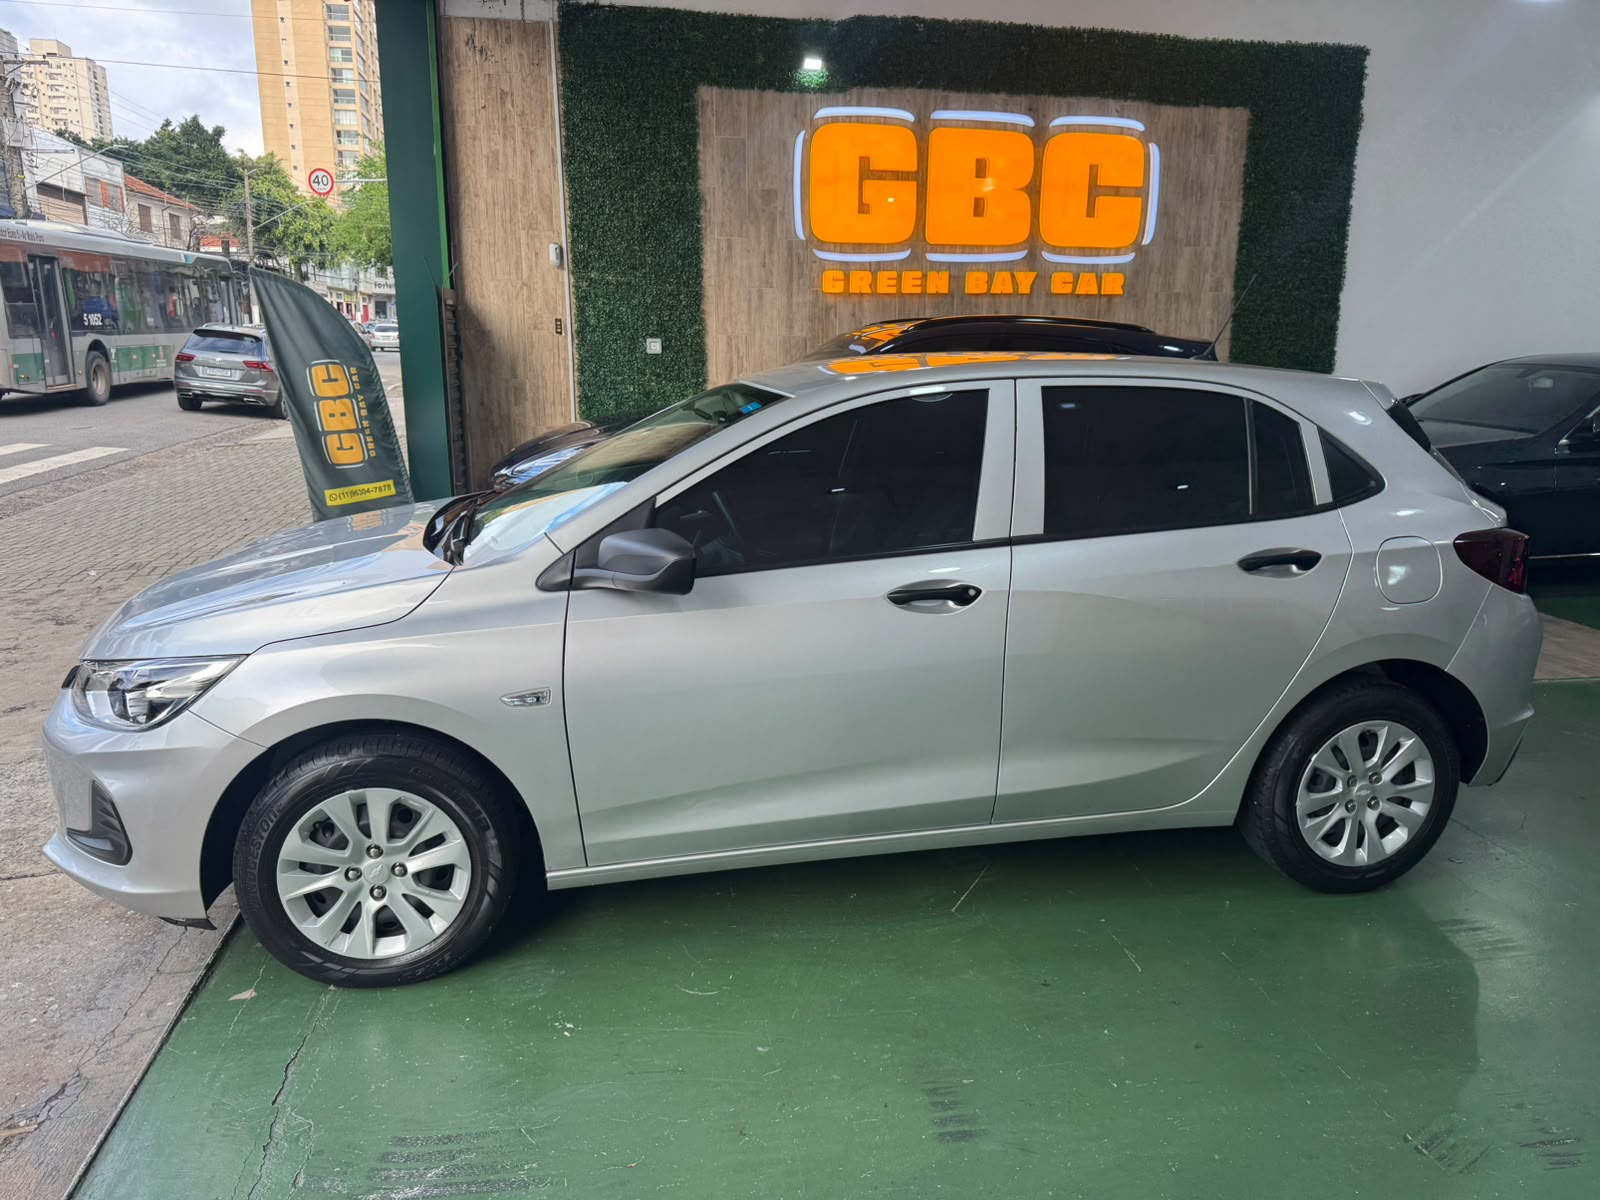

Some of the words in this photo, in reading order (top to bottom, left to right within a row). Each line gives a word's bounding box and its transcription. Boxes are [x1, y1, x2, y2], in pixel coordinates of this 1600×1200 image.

[312, 174, 329, 186] 40
[810, 122, 1145, 248] GBC
[822, 270, 950, 295] GREEN
[965, 271, 1038, 295] BAY
[1050, 271, 1126, 296] CAR
[350, 367, 361, 390] CAR
[311, 363, 365, 465] GBC
[357, 394, 368, 416] BAY
[362, 420, 376, 457] GREEN
